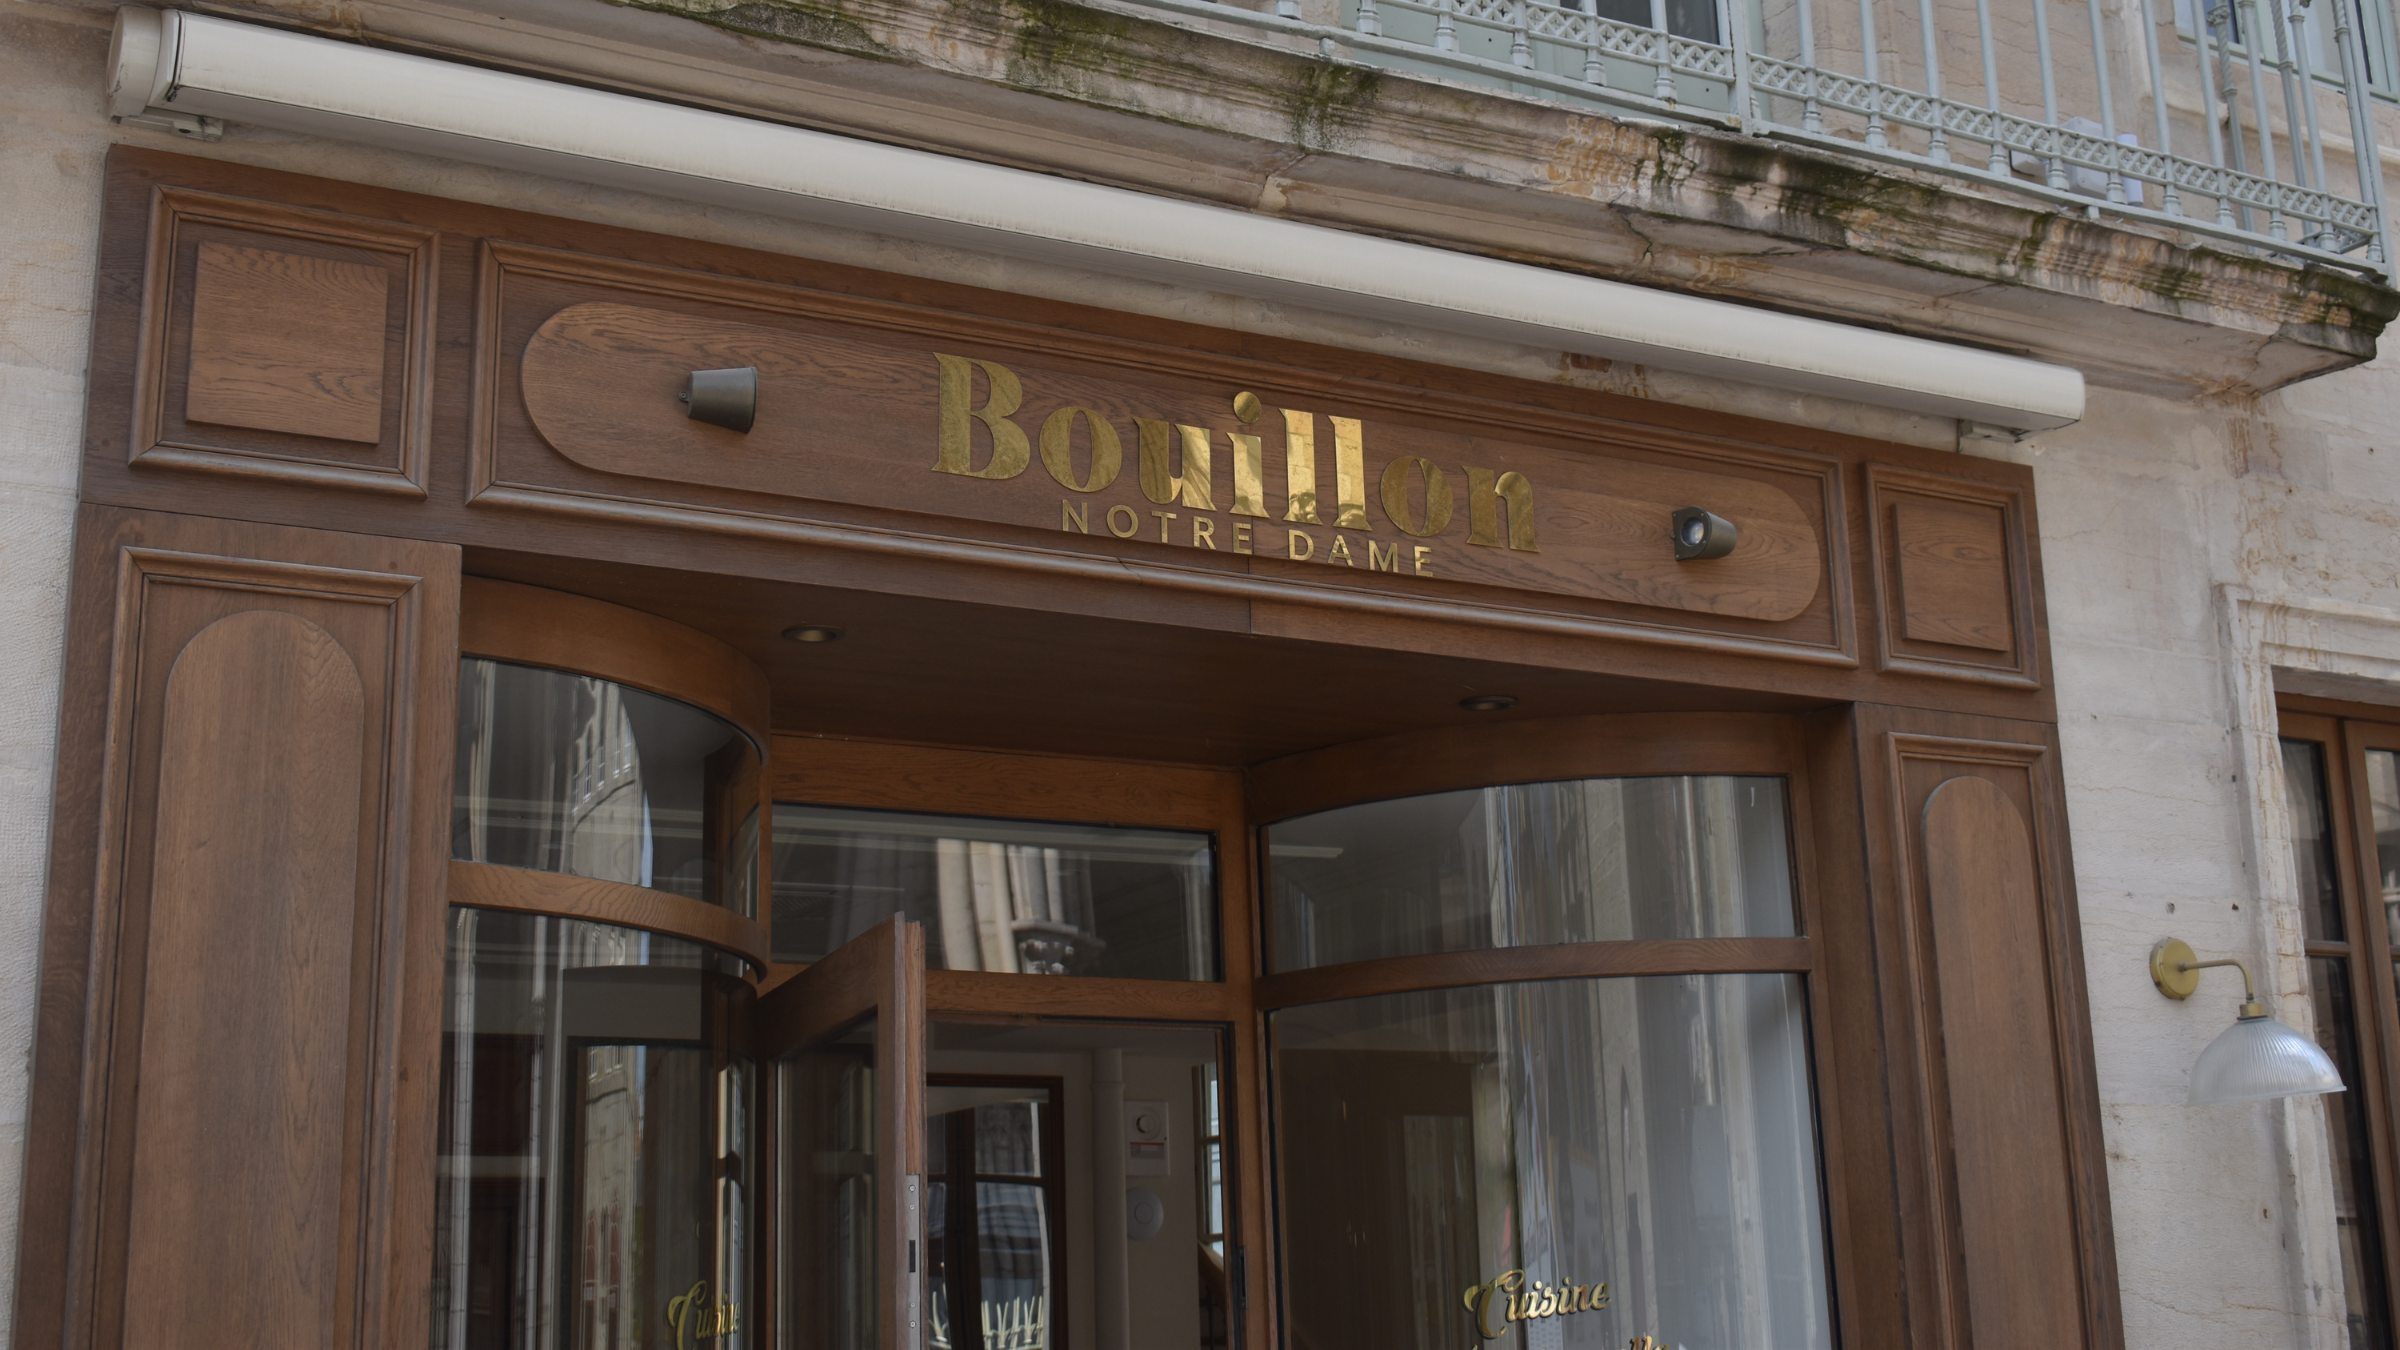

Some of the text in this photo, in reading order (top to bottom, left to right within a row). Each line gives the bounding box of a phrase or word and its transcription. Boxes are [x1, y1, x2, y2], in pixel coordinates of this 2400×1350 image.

[931, 352, 1541, 553] Bouillon
[1061, 499, 1435, 578] NOTRE DAME
[1462, 1269, 1612, 1338] Cuisine
